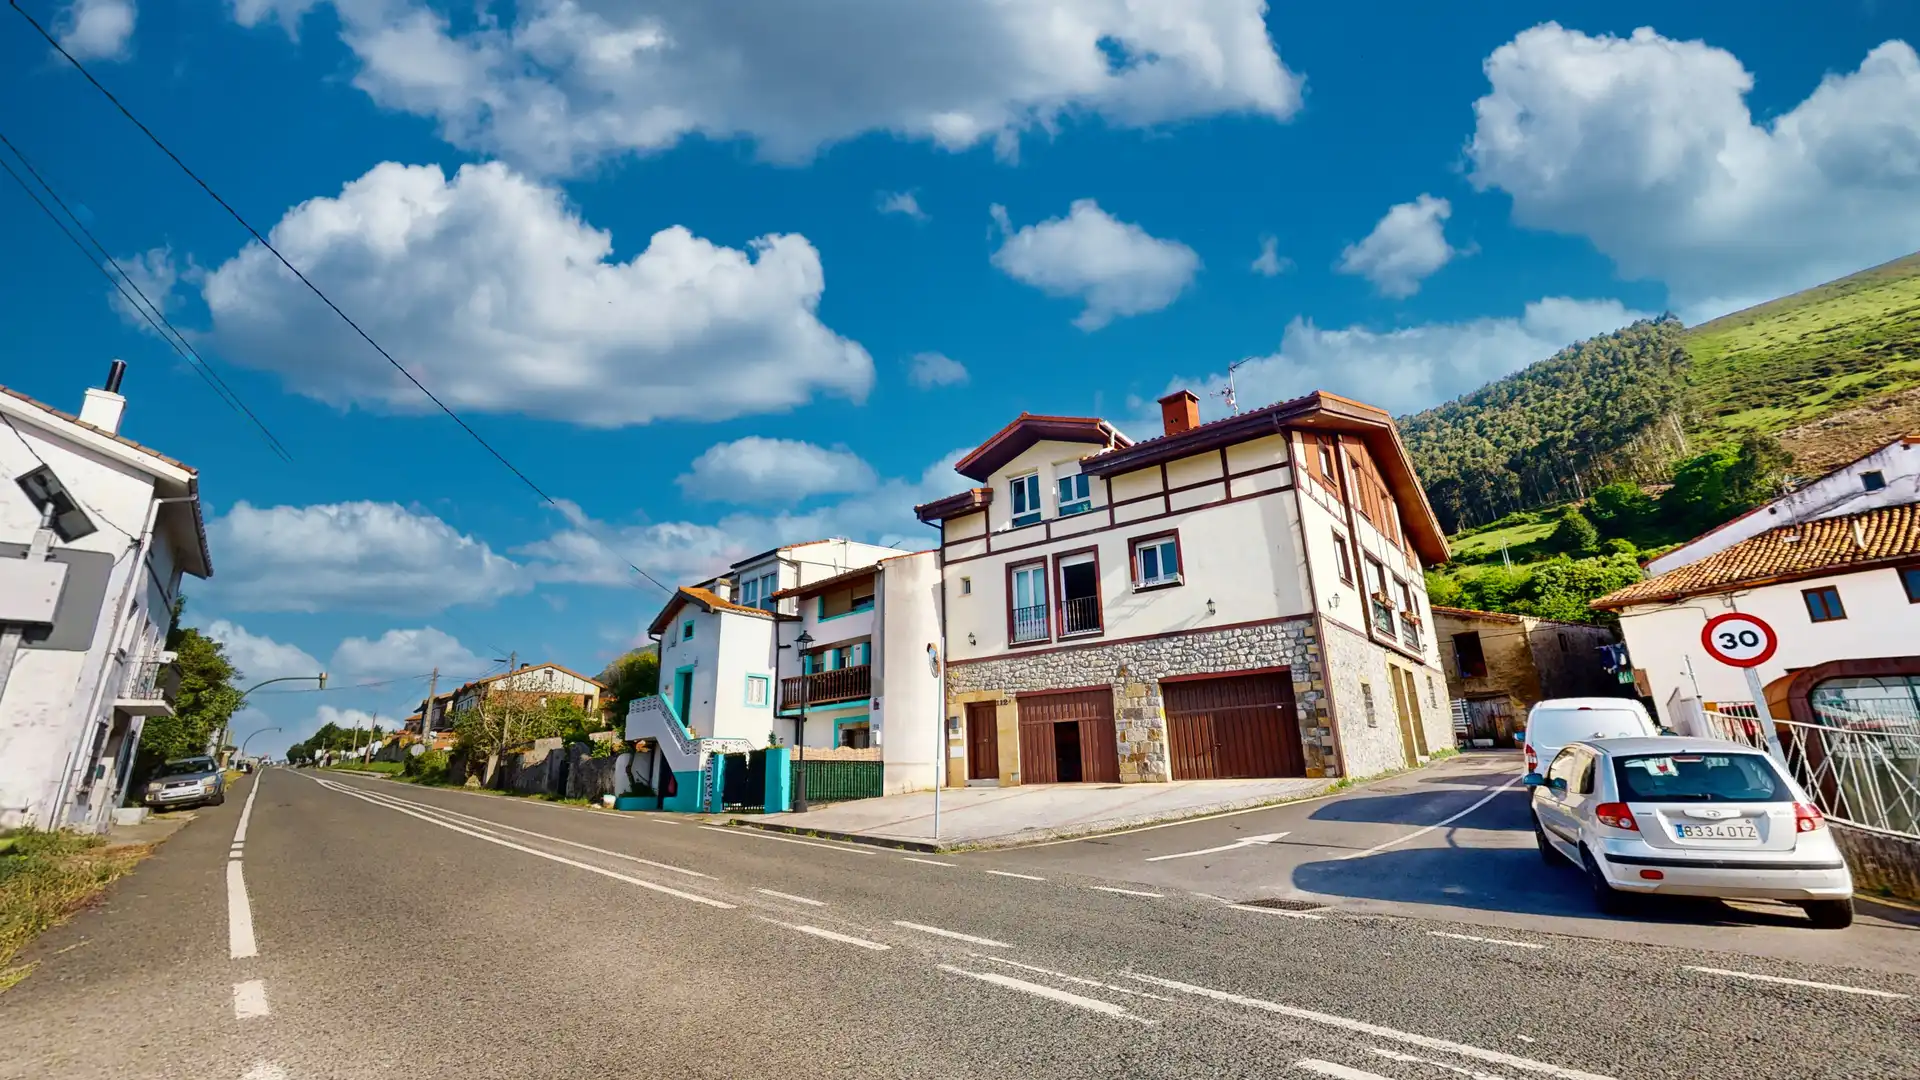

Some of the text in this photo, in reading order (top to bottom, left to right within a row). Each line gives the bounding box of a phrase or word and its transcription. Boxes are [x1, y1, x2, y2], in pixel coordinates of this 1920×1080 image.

[1718, 630, 1759, 650] 30
[1685, 826, 1757, 838] 8334 DTZ
